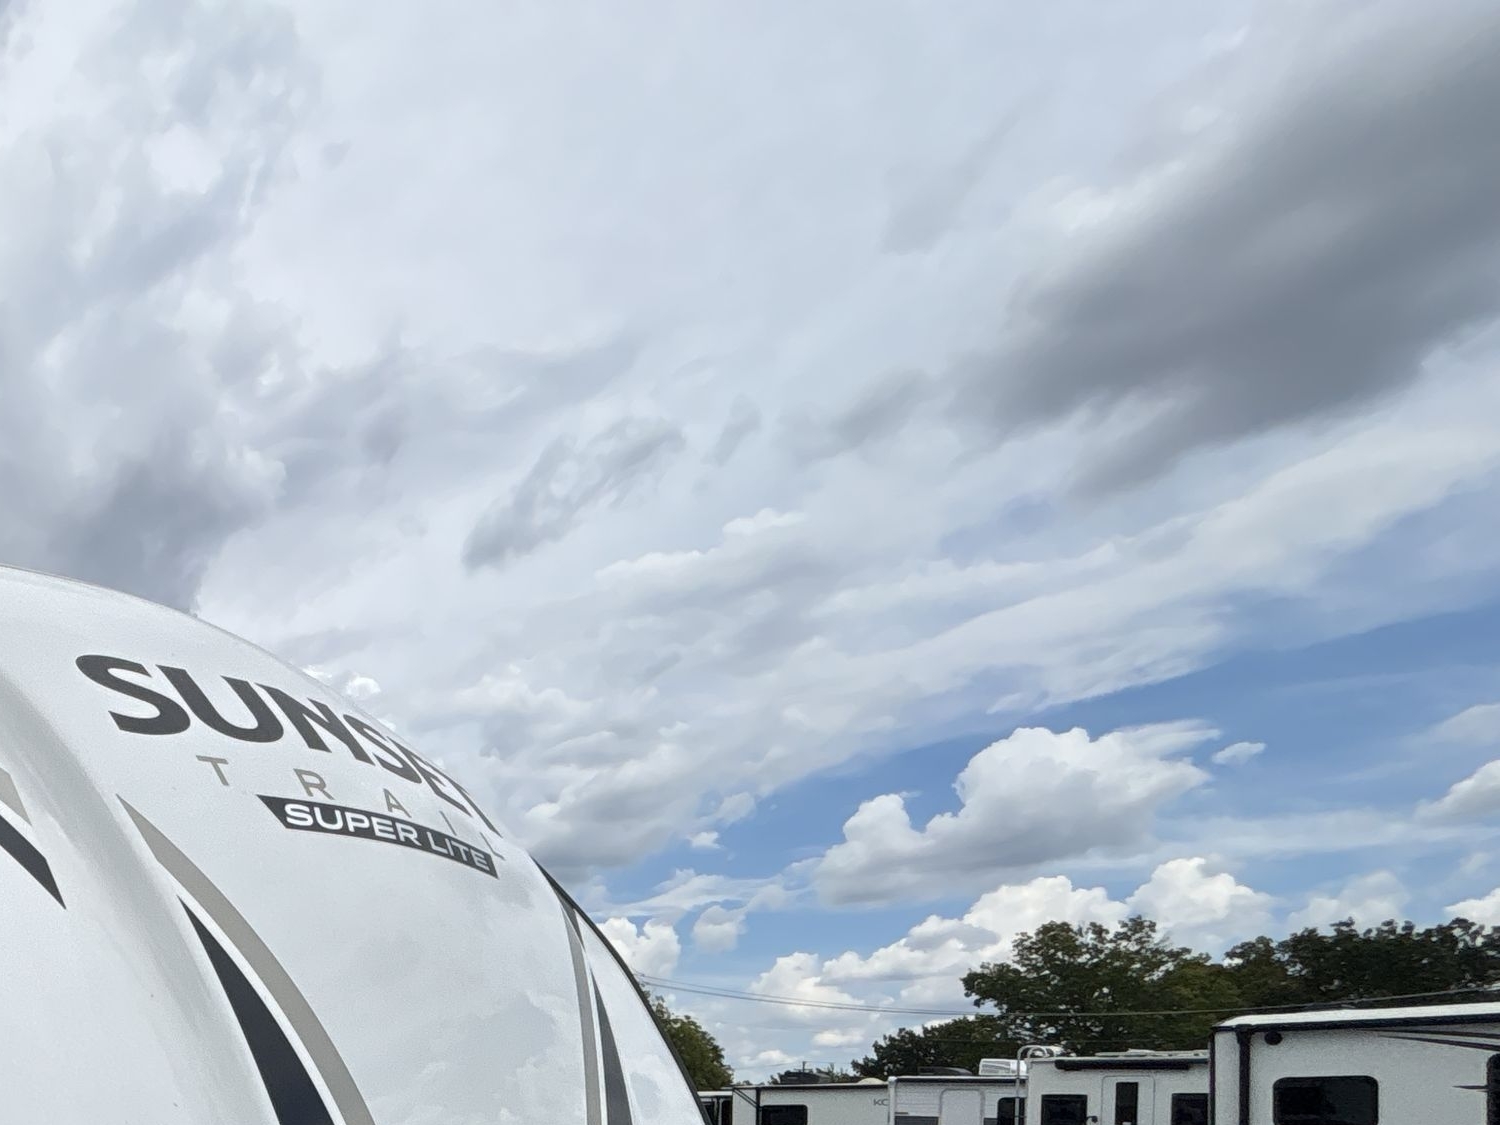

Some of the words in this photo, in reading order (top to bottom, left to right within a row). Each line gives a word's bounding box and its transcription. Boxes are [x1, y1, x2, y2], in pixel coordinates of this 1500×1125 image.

[76, 653, 503, 838] SUNSET
[195, 754, 506, 862] TRAIL
[283, 802, 421, 848] SUPER
[430, 830, 491, 872] LITE
